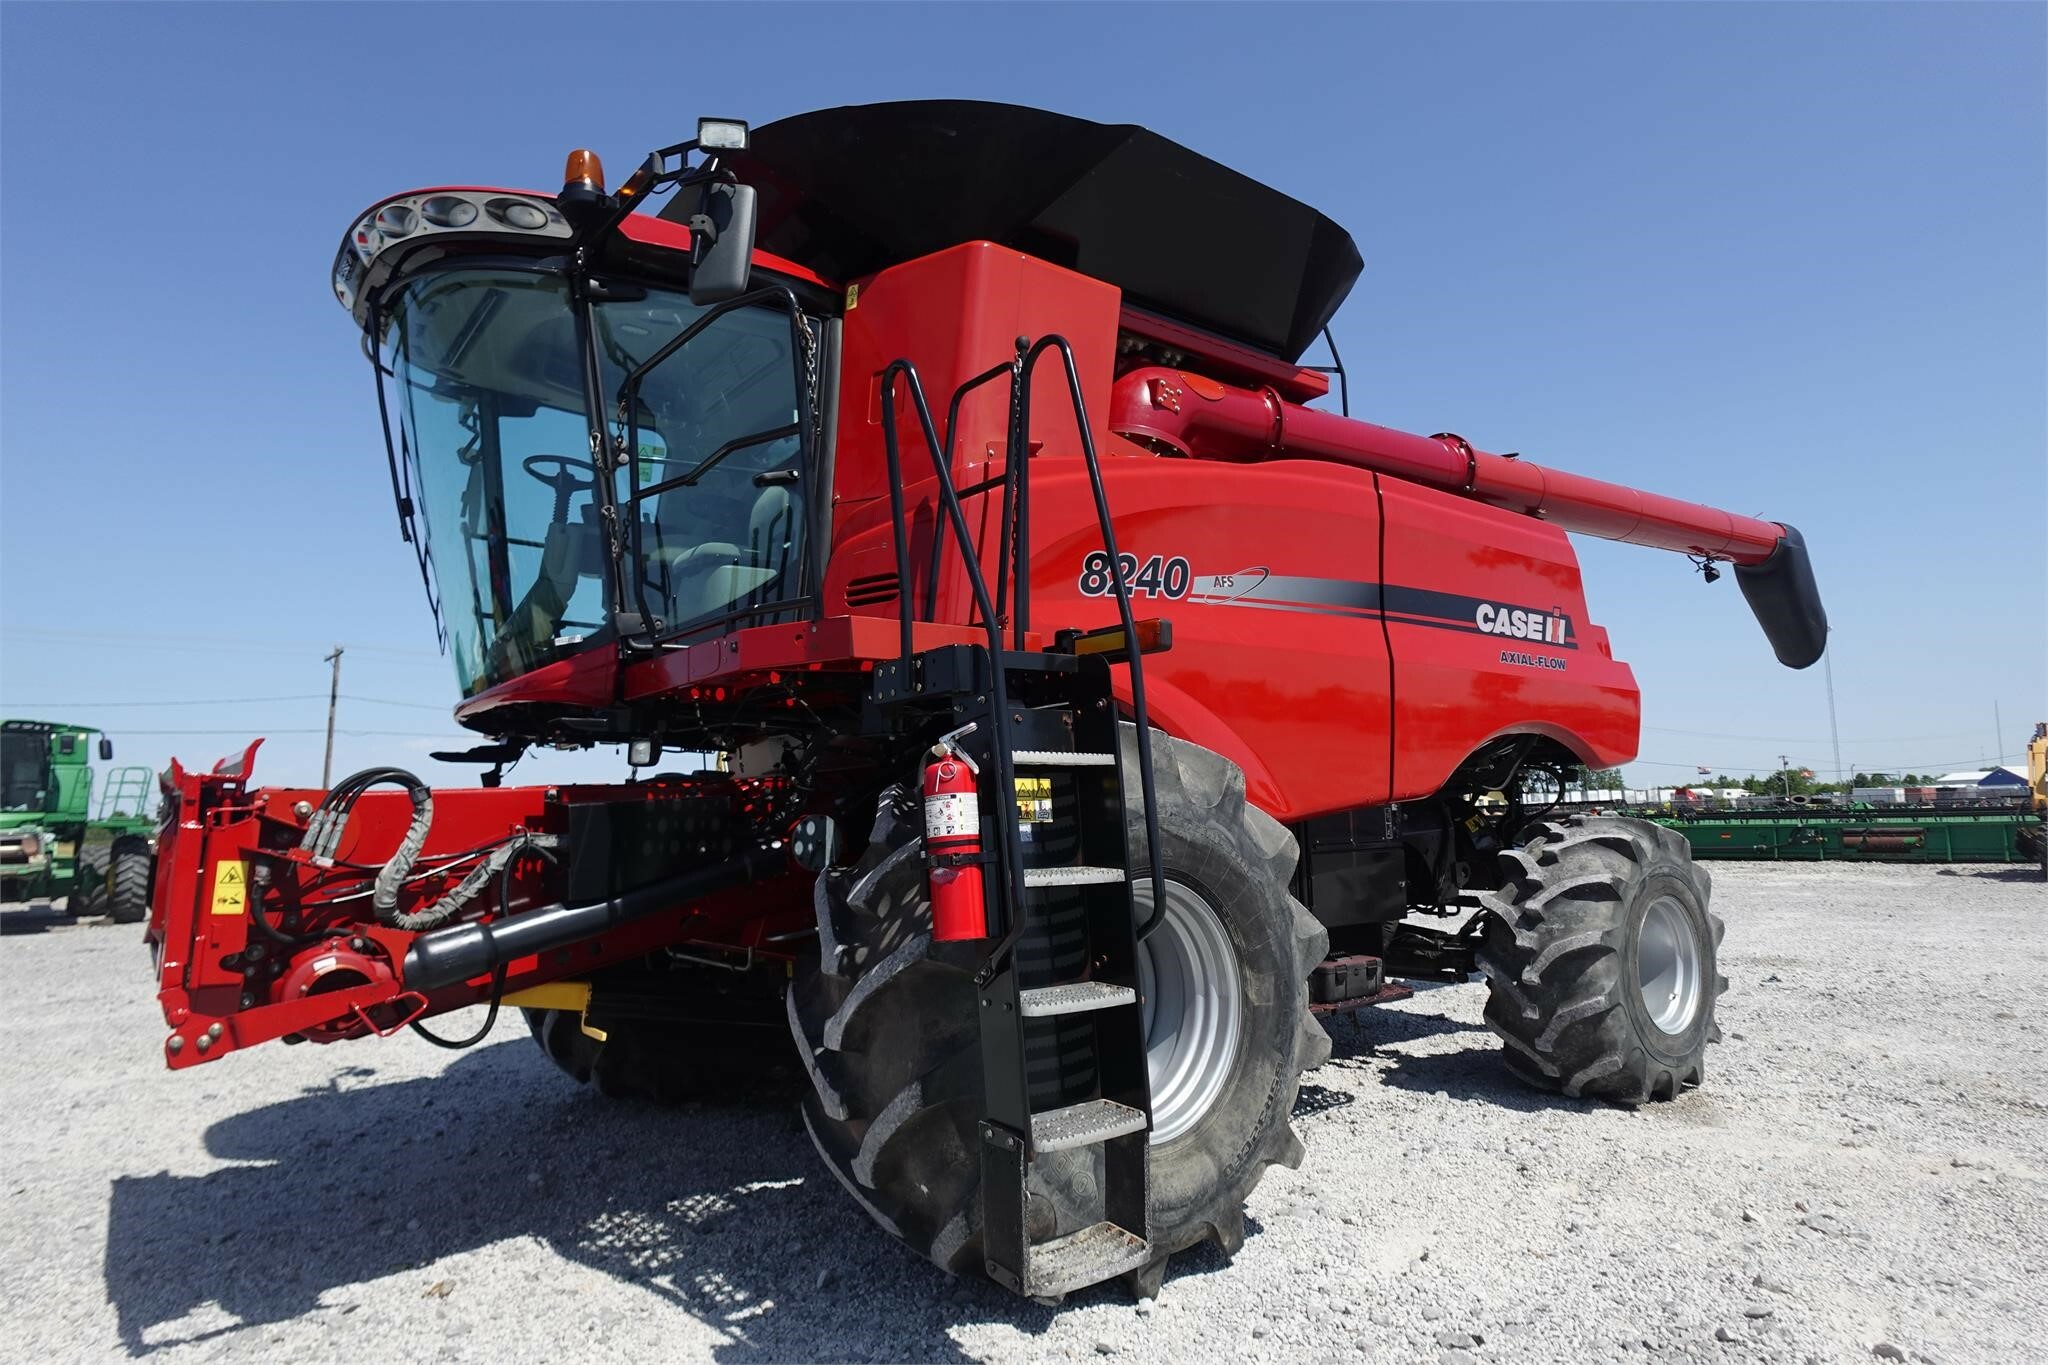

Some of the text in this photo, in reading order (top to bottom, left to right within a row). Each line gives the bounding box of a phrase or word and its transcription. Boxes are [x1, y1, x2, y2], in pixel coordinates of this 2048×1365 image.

[1079, 550, 1191, 600] 8240
[1212, 575, 1235, 589] AFS
[1500, 650, 1567, 671] AXIAL-FLOW
